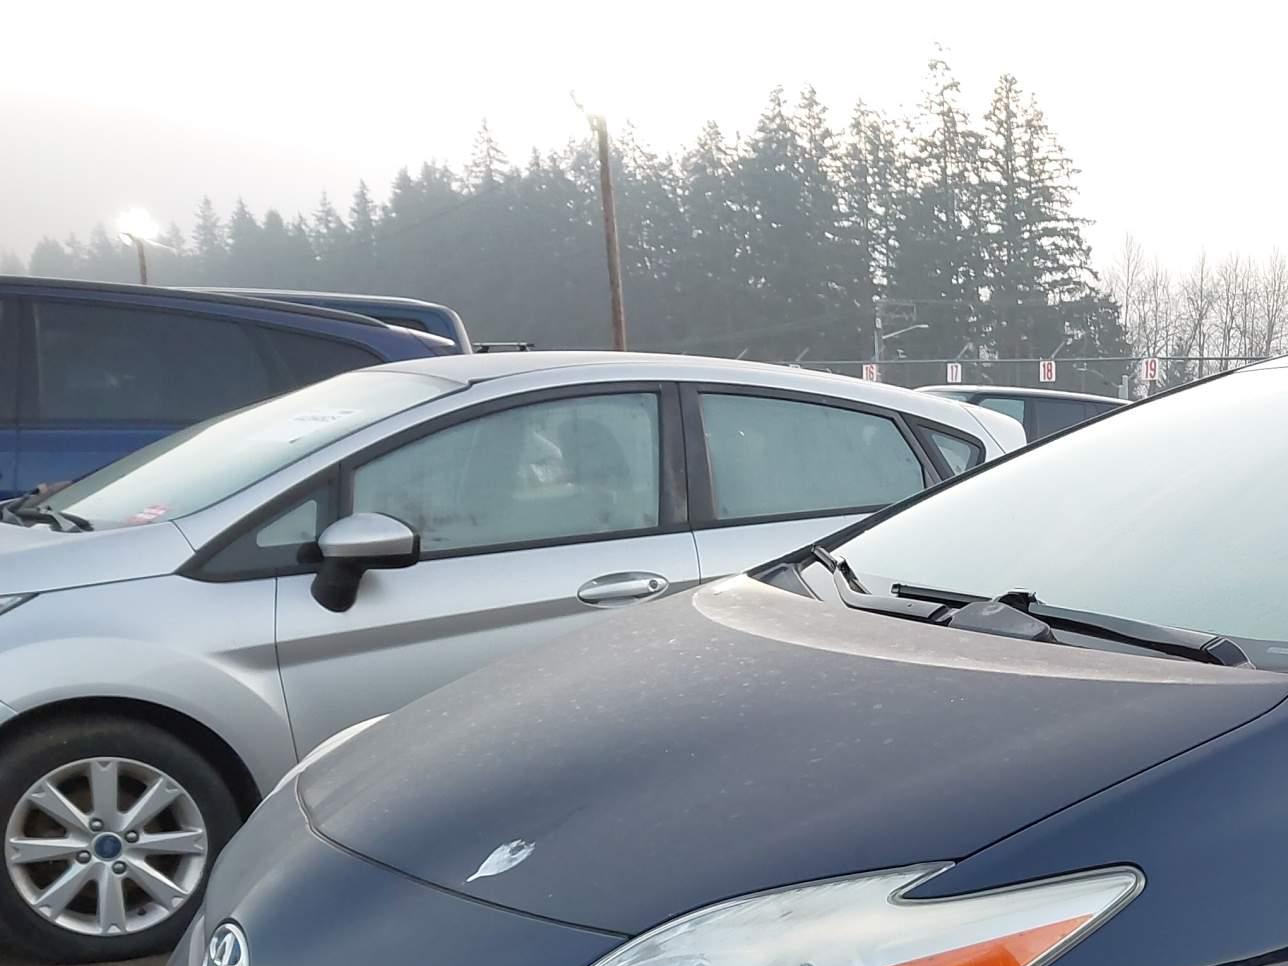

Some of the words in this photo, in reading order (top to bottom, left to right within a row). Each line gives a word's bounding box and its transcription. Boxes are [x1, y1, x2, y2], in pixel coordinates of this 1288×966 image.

[950, 364, 959, 382] 17
[1042, 362, 1053, 380] 18
[1145, 360, 1157, 379] 19
